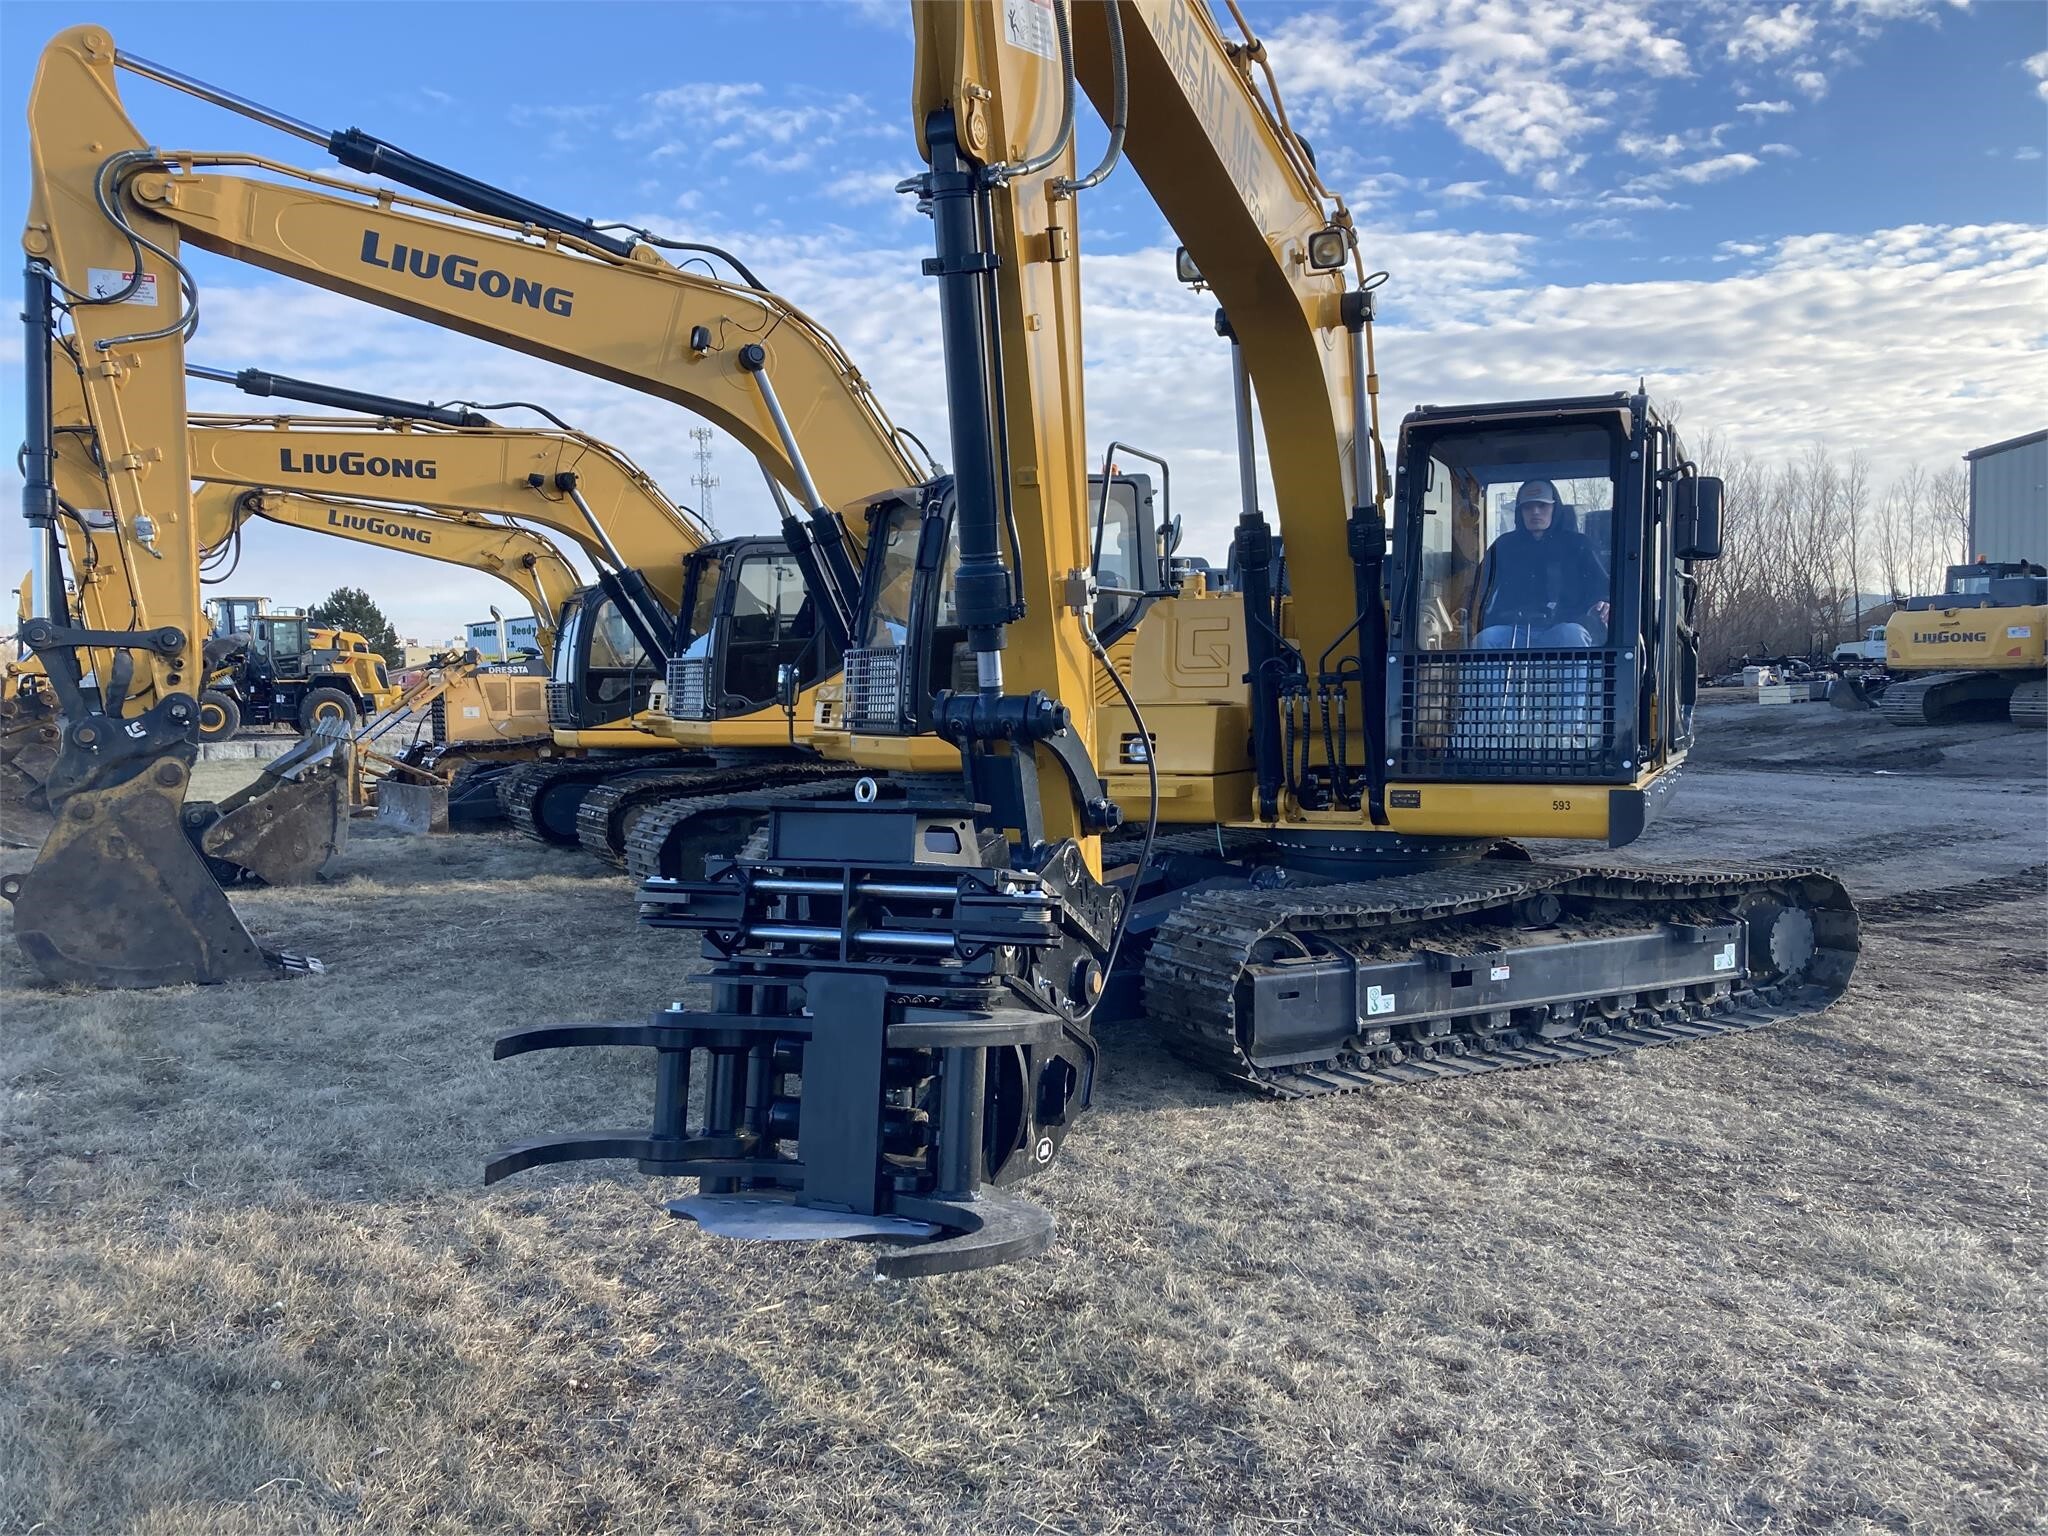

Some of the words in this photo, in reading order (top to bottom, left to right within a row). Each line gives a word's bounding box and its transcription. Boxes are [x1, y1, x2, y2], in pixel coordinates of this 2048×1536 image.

[1167, 0, 1230, 135] RENT
[1231, 106, 1262, 199] ME
[473, 627, 497, 637] Midwe
[488, 666, 529, 674] DRESSTA
[1552, 800, 1571, 811] 593
